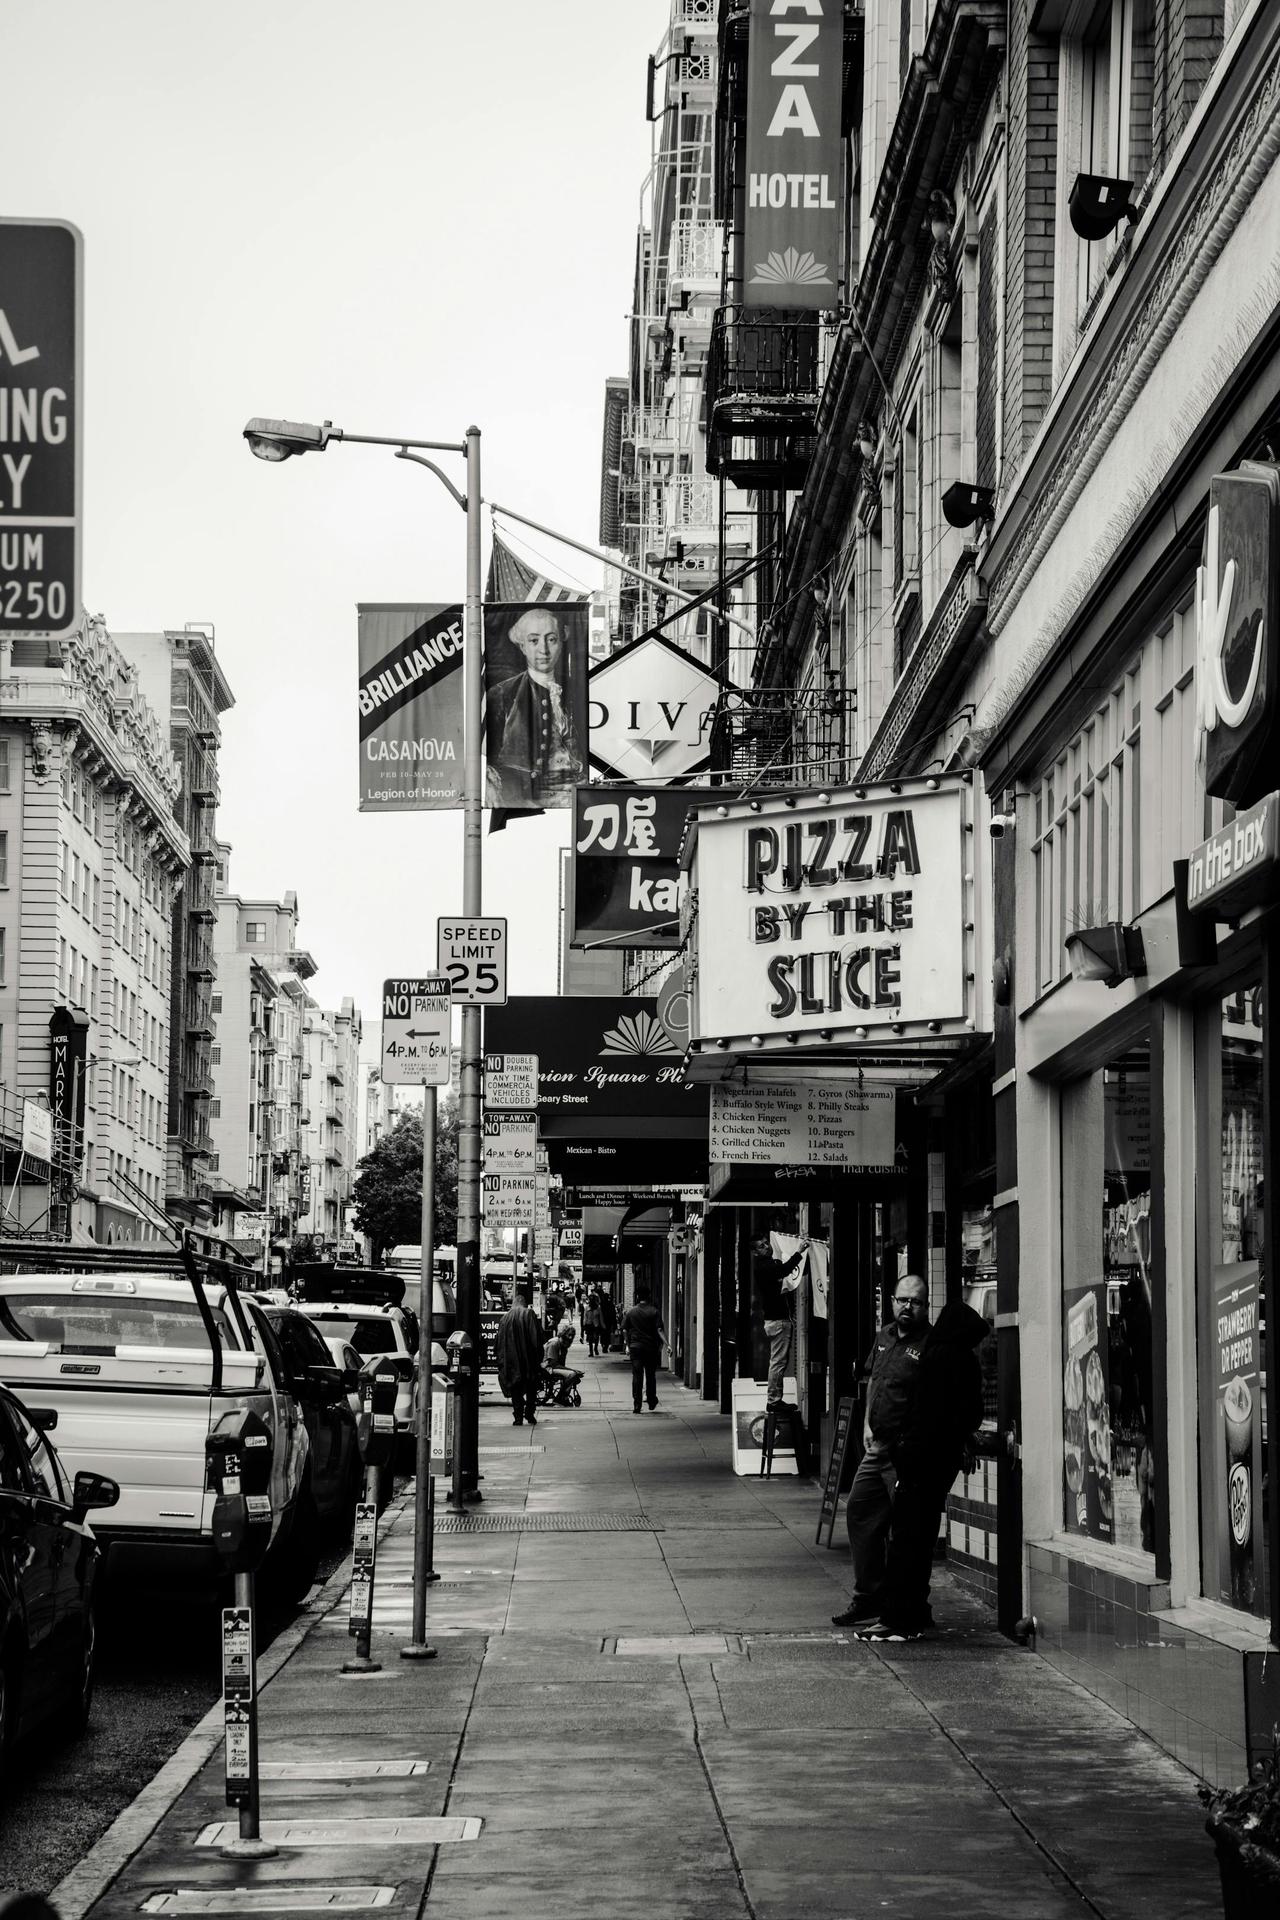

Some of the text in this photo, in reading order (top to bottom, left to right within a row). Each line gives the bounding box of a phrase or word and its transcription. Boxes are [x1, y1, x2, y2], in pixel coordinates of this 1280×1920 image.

[749, 173, 836, 209] HOTEL
[0, 581, 66, 619] 250
[359, 621, 464, 717] BRILLIANCE
[368, 788, 456, 801] Legion of Honor
[576, 796, 661, 857] 刀屋
[743, 810, 921, 893] PIZZA
[1188, 812, 1264, 901] in the box
[629, 866, 681, 913] ka
[751, 890, 913, 944] BY THE
[443, 927, 502, 941] SPEED
[451, 945, 495, 958] LIMIT
[446, 963, 499, 994] 25
[767, 945, 902, 1019] SLICE
[392, 981, 446, 994] TOW-AWAY
[385, 995, 449, 1016] NO PARKING
[487, 1057, 500, 1071] NO
[538, 1070, 578, 1082] nion
[584, 1066, 649, 1088] Square
[537, 1094, 588, 1104] Geary Street
[722, 1088, 764, 1098] Vegetarian
[767, 1088, 797, 1097] Falafels
[808, 1089, 894, 1101] 7. Gyros (Shawarma)
[712, 1100, 802, 1112] 2. Buffalo Style Wings
[808, 1102, 870, 1112] 8. Philly Steaks
[489, 1114, 531, 1122] TOW-AWAY
[712, 1112, 787, 1124] 3. Chicken Fingers
[808, 1115, 843, 1123] 9. Pizzas
[485, 1123, 533, 1134] NO PARKING
[722, 1125, 755, 1134] Chicken
[758, 1126, 791, 1137] Nuggets
[808, 1128, 855, 1139] 10. Burgers
[712, 1138, 785, 1148] 5. Grilled Chicken
[711, 1151, 771, 1160] 6. French Fries
[808, 1153, 849, 1162] 12. Salads
[868, 1165, 909, 1174] cuisine
[485, 1177, 499, 1190] NO
[502, 1180, 535, 1190] PARKING
[1218, 1302, 1255, 1344] STRAWBERRY
[1222, 1336, 1252, 1374] DR PEPPER
